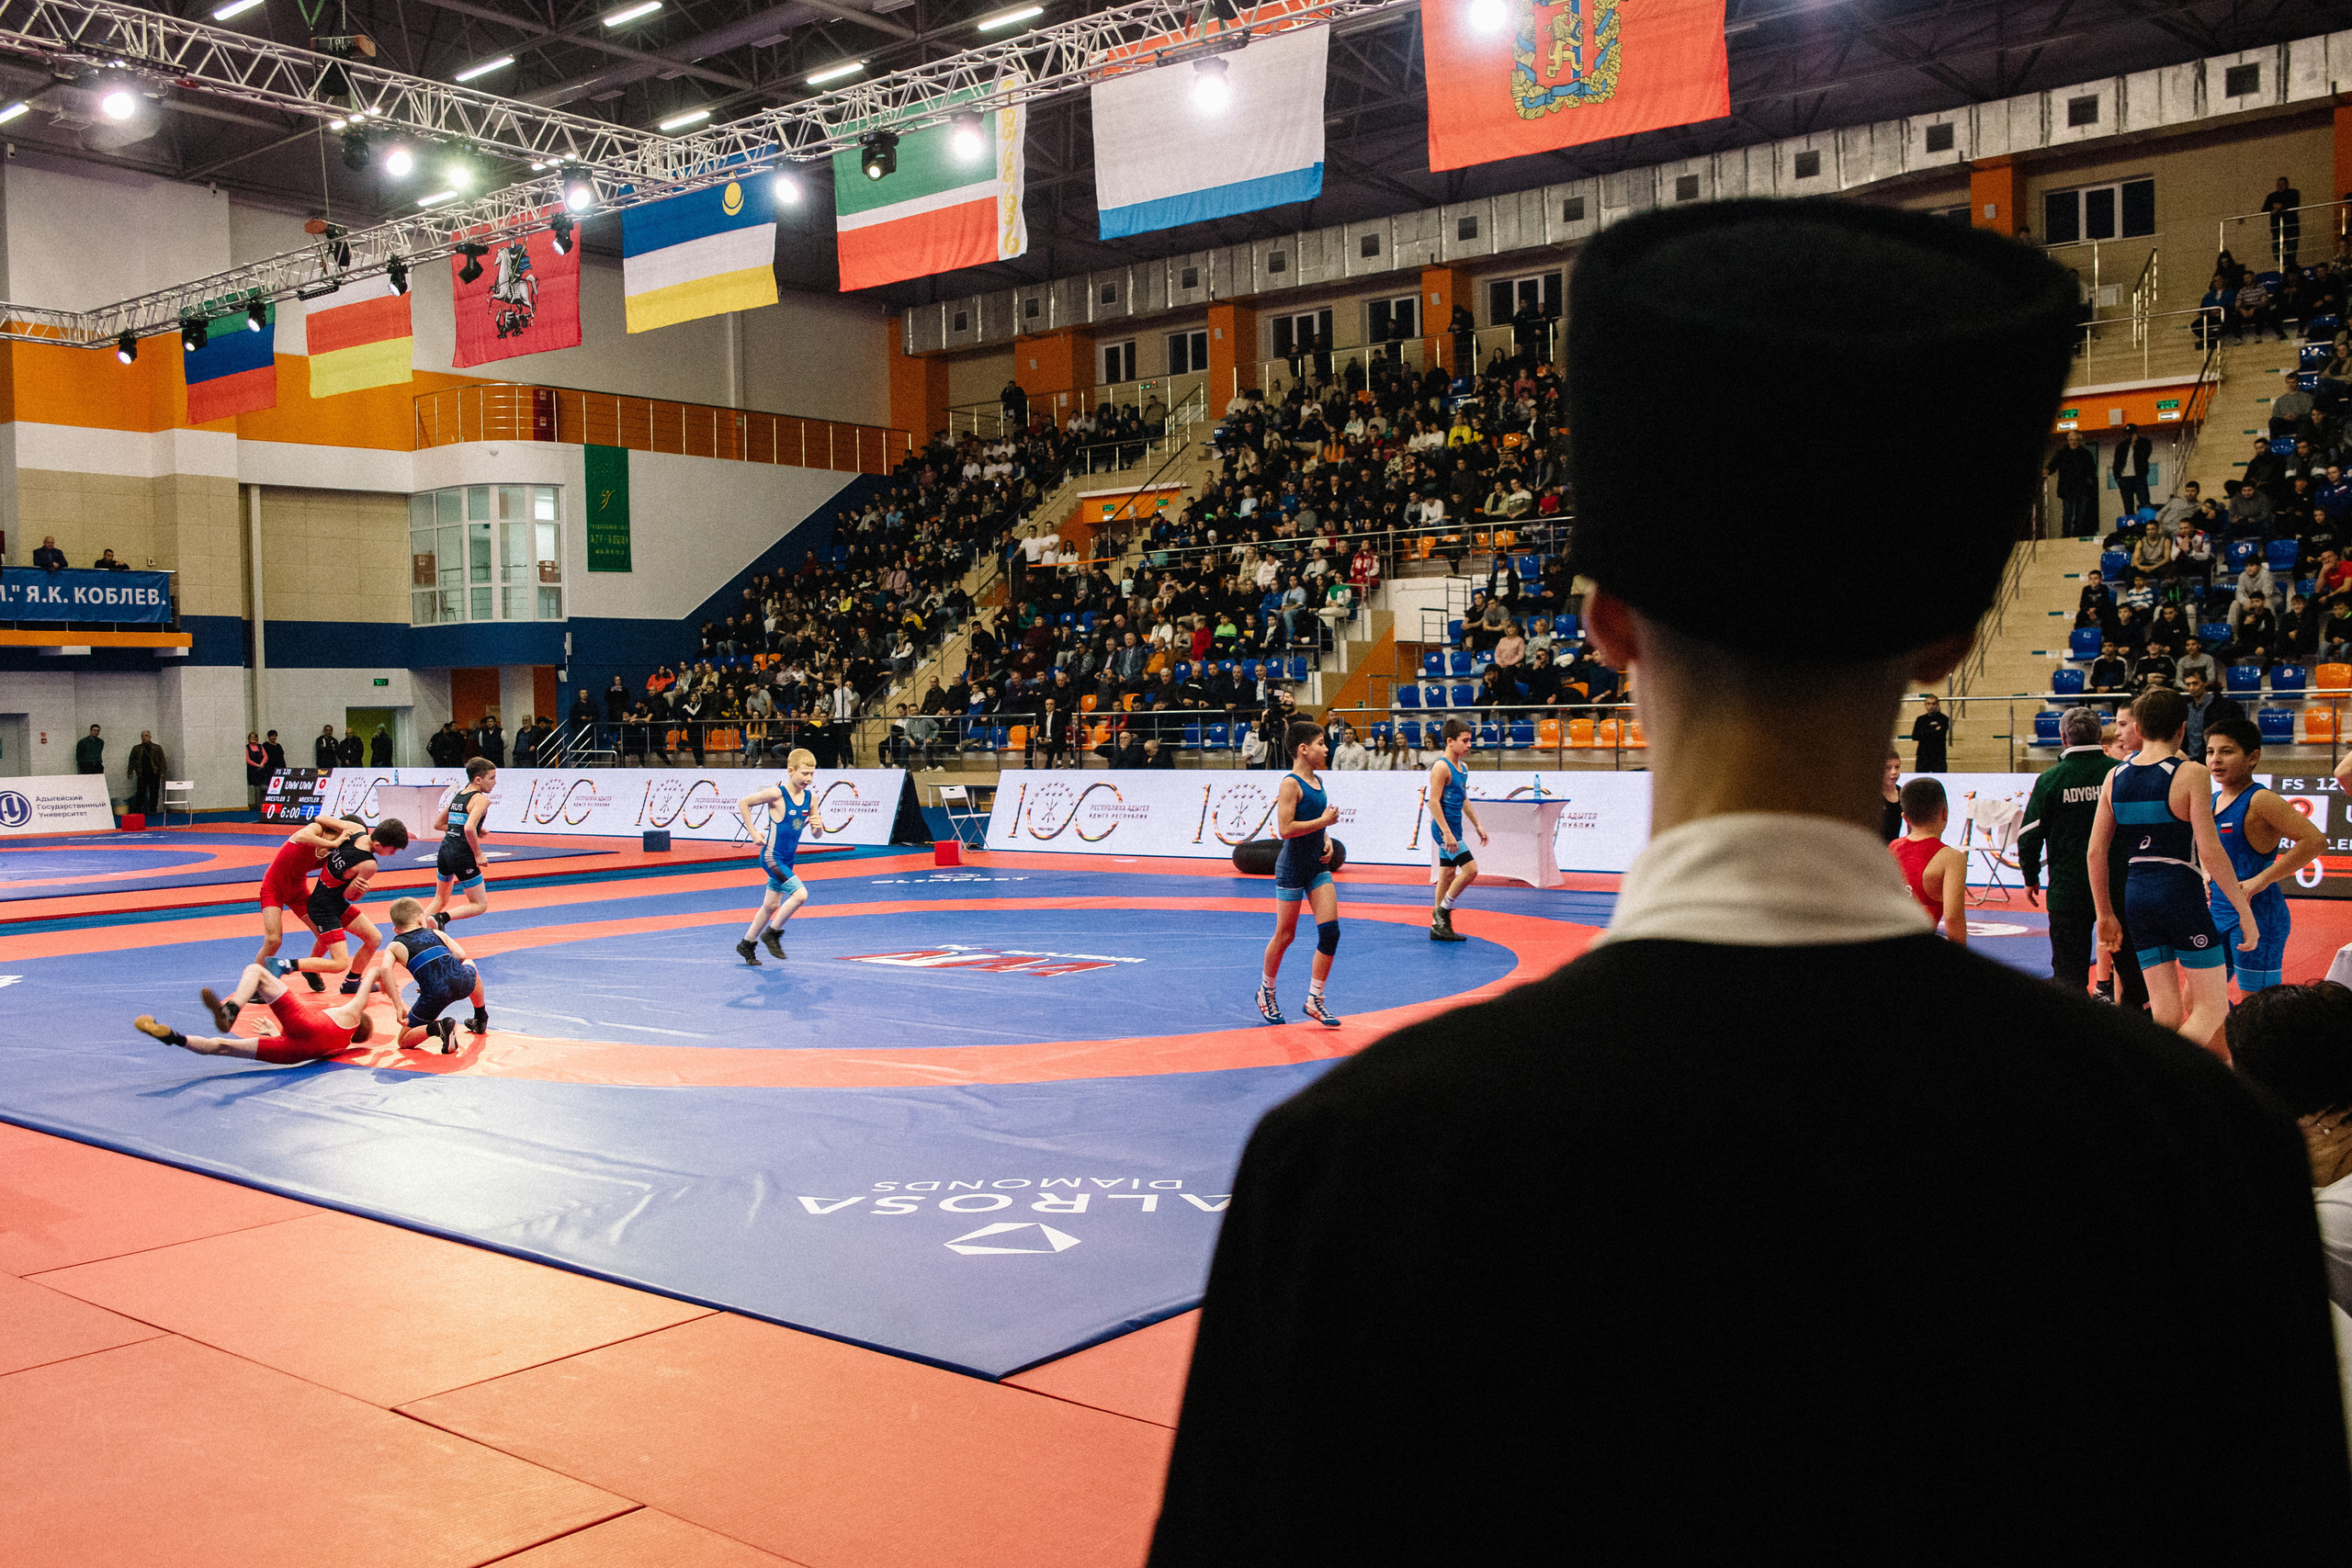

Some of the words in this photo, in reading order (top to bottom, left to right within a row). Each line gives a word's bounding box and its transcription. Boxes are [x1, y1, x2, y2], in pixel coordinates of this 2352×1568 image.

[27, 586, 69, 604] Я.К.
[74, 587, 166, 605] КОБЛЕВ.
[2281, 778, 2305, 790] FS
[2063, 785, 2102, 803] ADYGH
[37, 802, 107, 810] Государственный
[266, 804, 276, 819] 0
[279, 807, 300, 818] 6:00
[306, 806, 314, 820] 0
[450, 803, 464, 811] RUS
[872, 1177, 1183, 1192] DIAMONDS
[797, 1192, 1232, 1215] ALROSA
